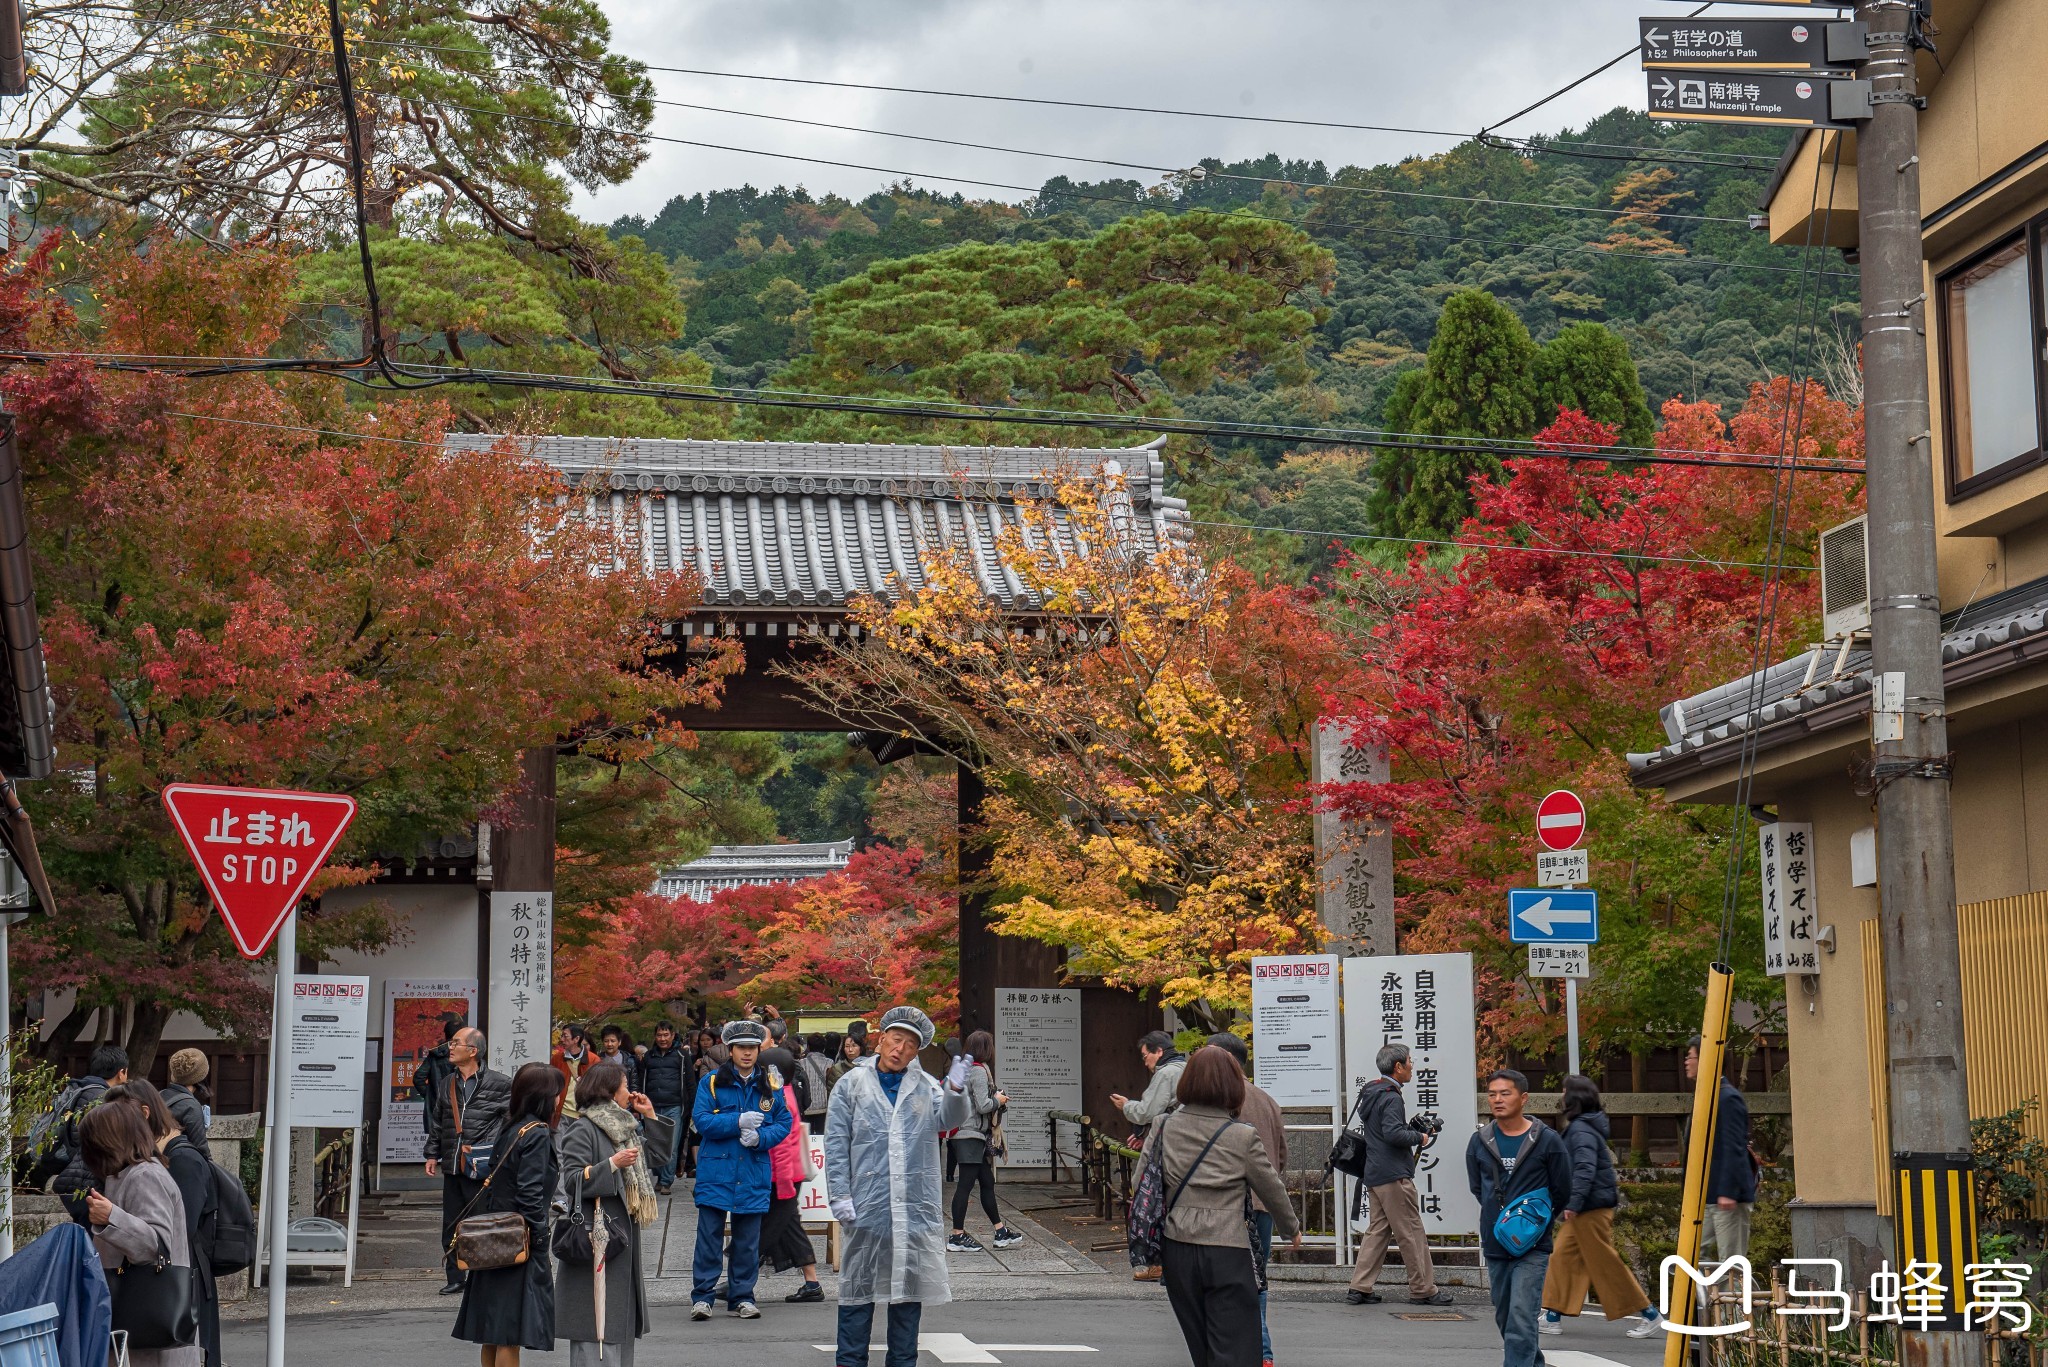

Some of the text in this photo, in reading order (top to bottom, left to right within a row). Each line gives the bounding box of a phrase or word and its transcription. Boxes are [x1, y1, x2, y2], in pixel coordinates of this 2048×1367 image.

[1671, 29, 1744, 47] 哲学の道
[1673, 48, 1758, 58] Philosopher's Path
[1708, 82, 1761, 101] 南禅寺
[1709, 101, 1782, 113] Nanzenji Temple
[203, 807, 316, 848] 止まれ
[221, 853, 298, 886] STOP
[1764, 833, 1780, 941] 哲学そば
[1785, 831, 1813, 940] 哲学そば
[1531, 947, 1586, 959] 自動車(二輪を除く)
[801, 1187, 828, 1210] 止
